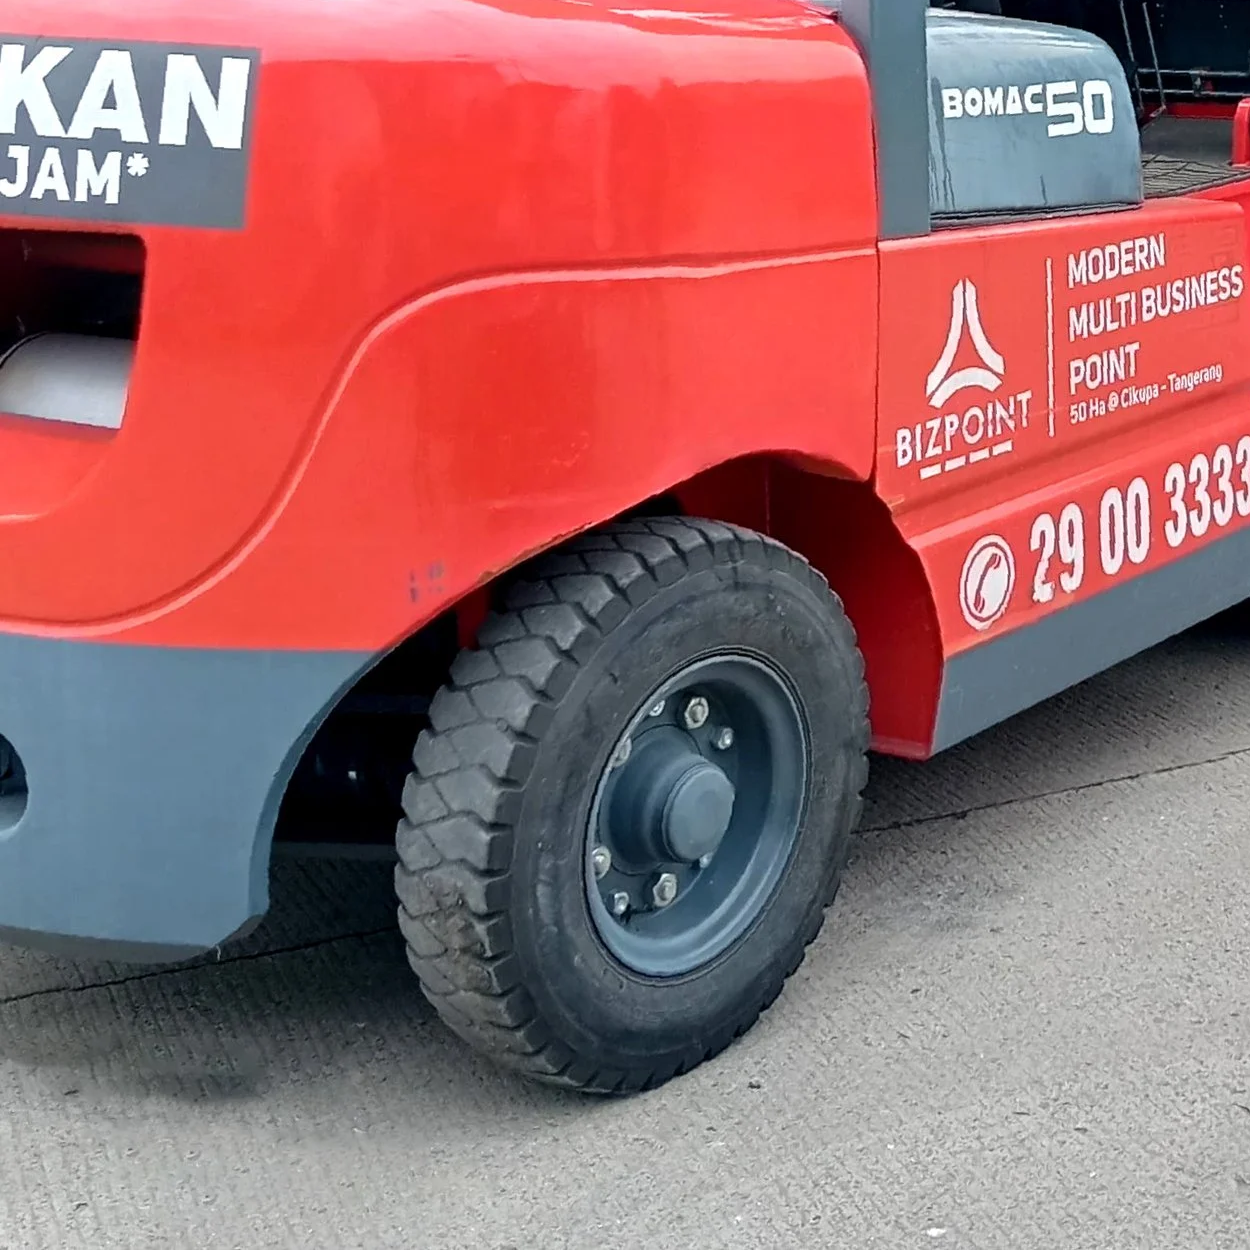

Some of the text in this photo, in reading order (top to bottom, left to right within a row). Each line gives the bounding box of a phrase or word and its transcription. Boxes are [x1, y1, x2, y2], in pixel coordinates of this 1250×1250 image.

[0, 44, 251, 150] KAN
[1066, 232, 1166, 289] MODERN
[1068, 264, 1245, 343] MULTI BUSINESS
[1069, 341, 1141, 396] POINT
[1069, 401, 1087, 425] 50
[1088, 397, 1106, 419] Ha
[1120, 383, 1159, 409] Cikupa
[1167, 364, 1223, 393] Tangerang
[895, 389, 1033, 468] BIZPOINT
[1030, 502, 1086, 604] 29
[1098, 476, 1152, 576] 00
